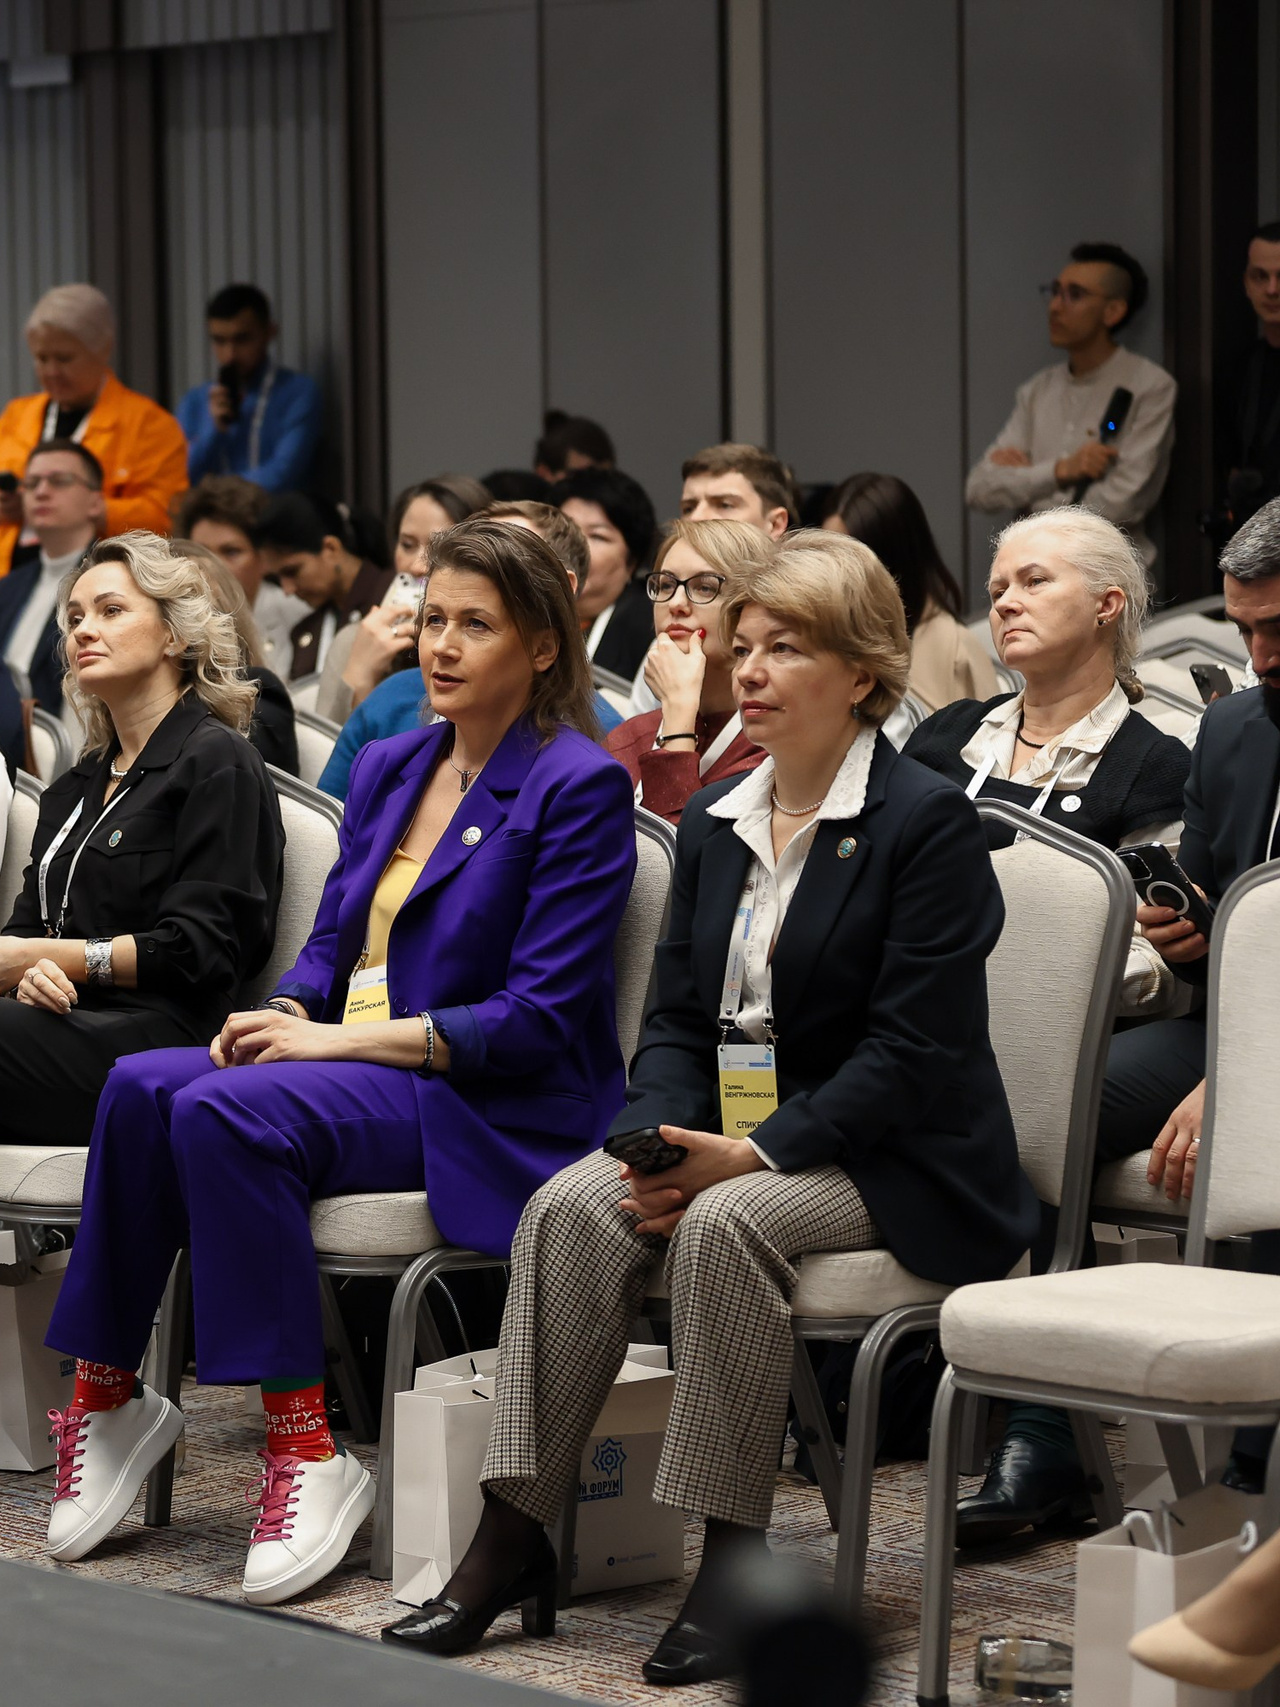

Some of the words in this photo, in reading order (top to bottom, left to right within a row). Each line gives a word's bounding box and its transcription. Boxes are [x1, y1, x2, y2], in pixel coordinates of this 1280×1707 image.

[348, 1000, 386, 1015] БАКУРСКАЯ
[76, 1357, 116, 1375] erry
[266, 1416, 324, 1435] ristmas
[589, 1479, 620, 1494] ФОРУМ
